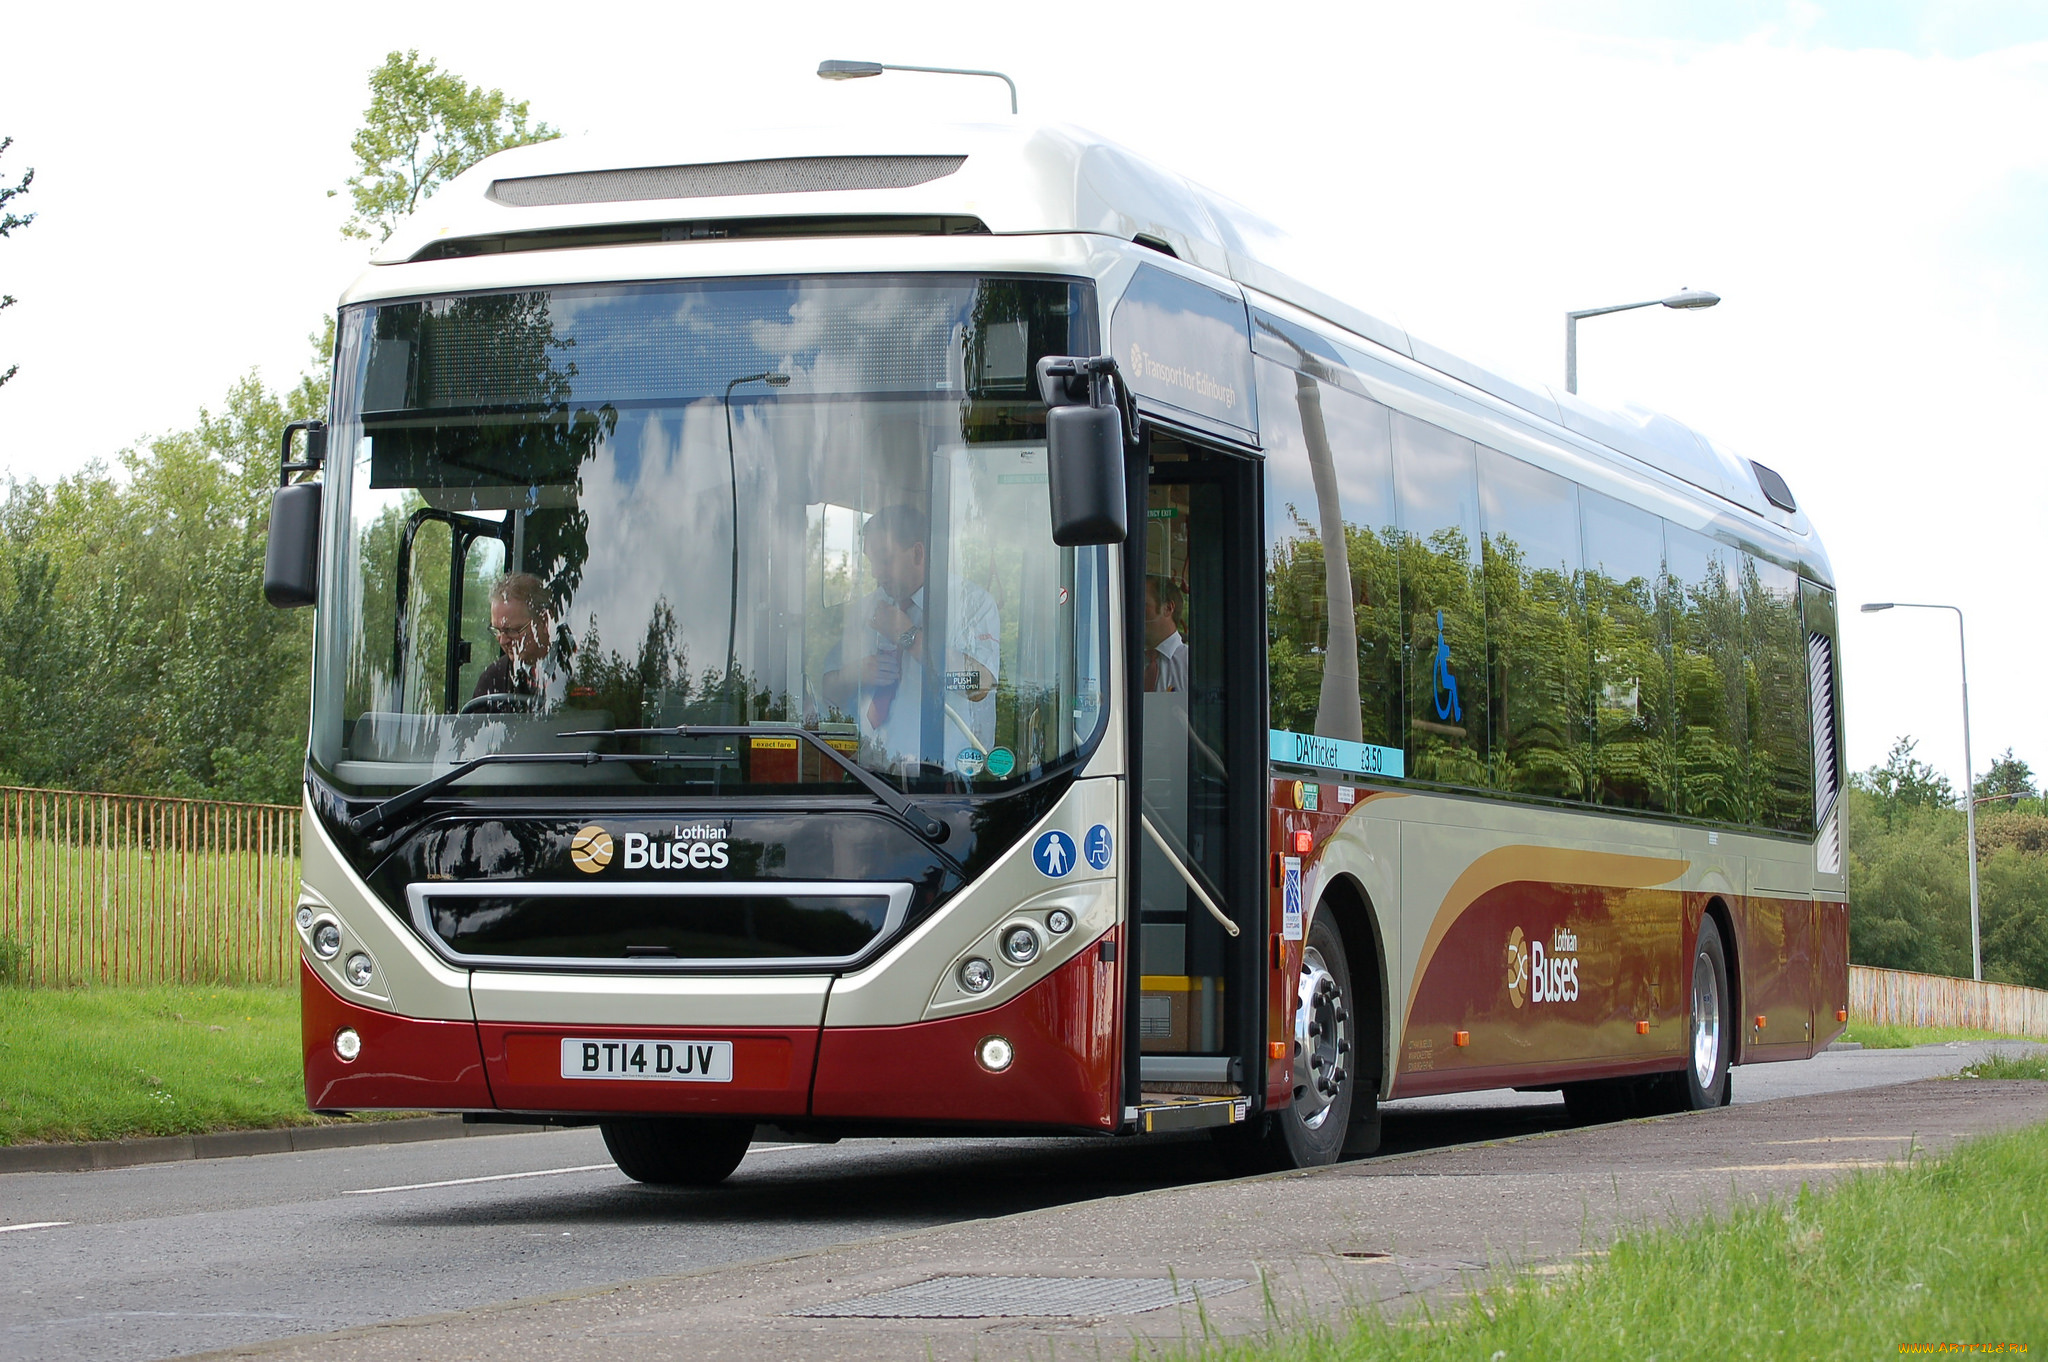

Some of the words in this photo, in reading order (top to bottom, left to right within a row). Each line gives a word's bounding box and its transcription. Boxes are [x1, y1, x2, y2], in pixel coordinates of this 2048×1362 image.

[1142, 351, 1184, 387] Transport
[1183, 365, 1196, 392] for
[1195, 370, 1237, 409] Edinburgh
[953, 676, 972, 685] PUSH
[756, 739, 776, 748] exact
[777, 739, 792, 748] fare
[1360, 746, 1383, 773] £3.50
[674, 824, 727, 840] Lothian
[623, 832, 729, 870] Buses
[1554, 927, 1578, 952] Lothian
[1532, 940, 1579, 1003] Buses
[582, 1042, 647, 1073] BT14
[655, 1044, 713, 1075] DJV
